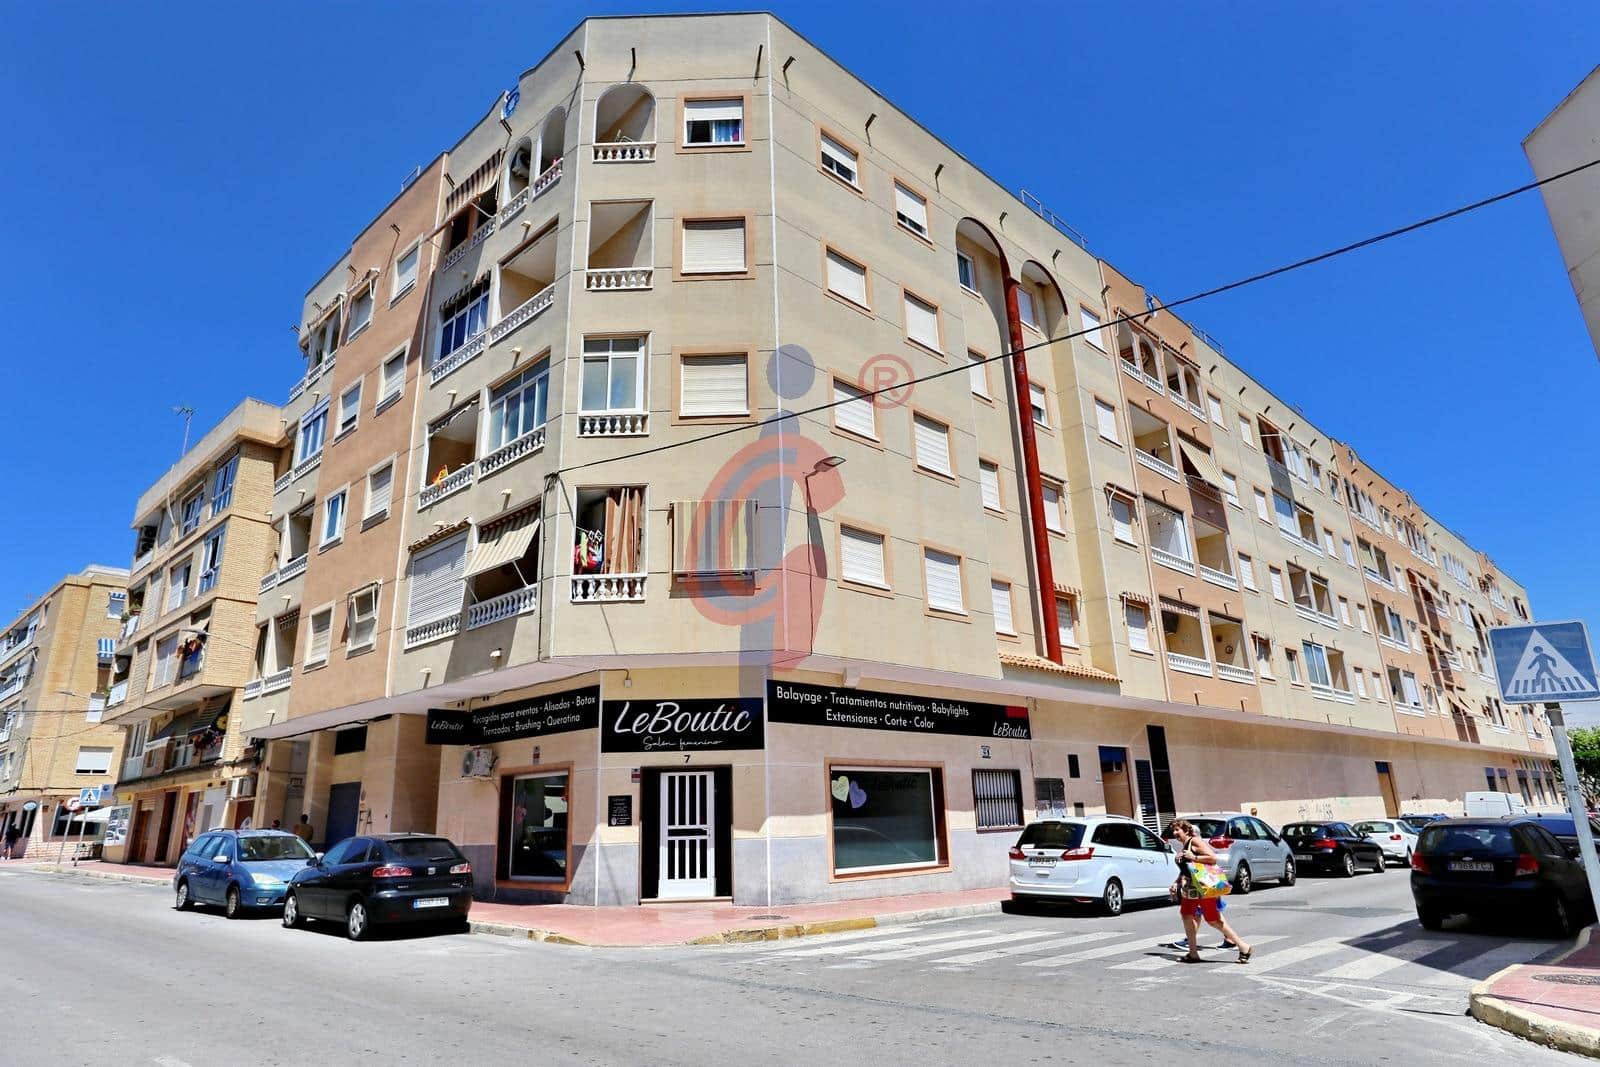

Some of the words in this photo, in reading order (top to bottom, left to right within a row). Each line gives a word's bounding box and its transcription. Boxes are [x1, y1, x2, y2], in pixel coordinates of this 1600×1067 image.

[501, 711, 515, 720] para
[516, 706, 539, 717] eventos
[544, 697, 570, 712] Alisados
[576, 696, 596, 705] Botox
[776, 686, 822, 704] Balayage
[830, 691, 887, 709] Tratamientos
[890, 701, 926, 713] nutritivos
[931, 702, 969, 718] Babylights
[483, 725, 511, 737] Trenzados
[515, 717, 541, 731] Brushing
[614, 701, 752, 734] LeBoutic
[826, 708, 878, 724] Extensiones
[884, 713, 908, 727] Corte
[914, 716, 935, 729] Color
[684, 754, 691, 763] 7
